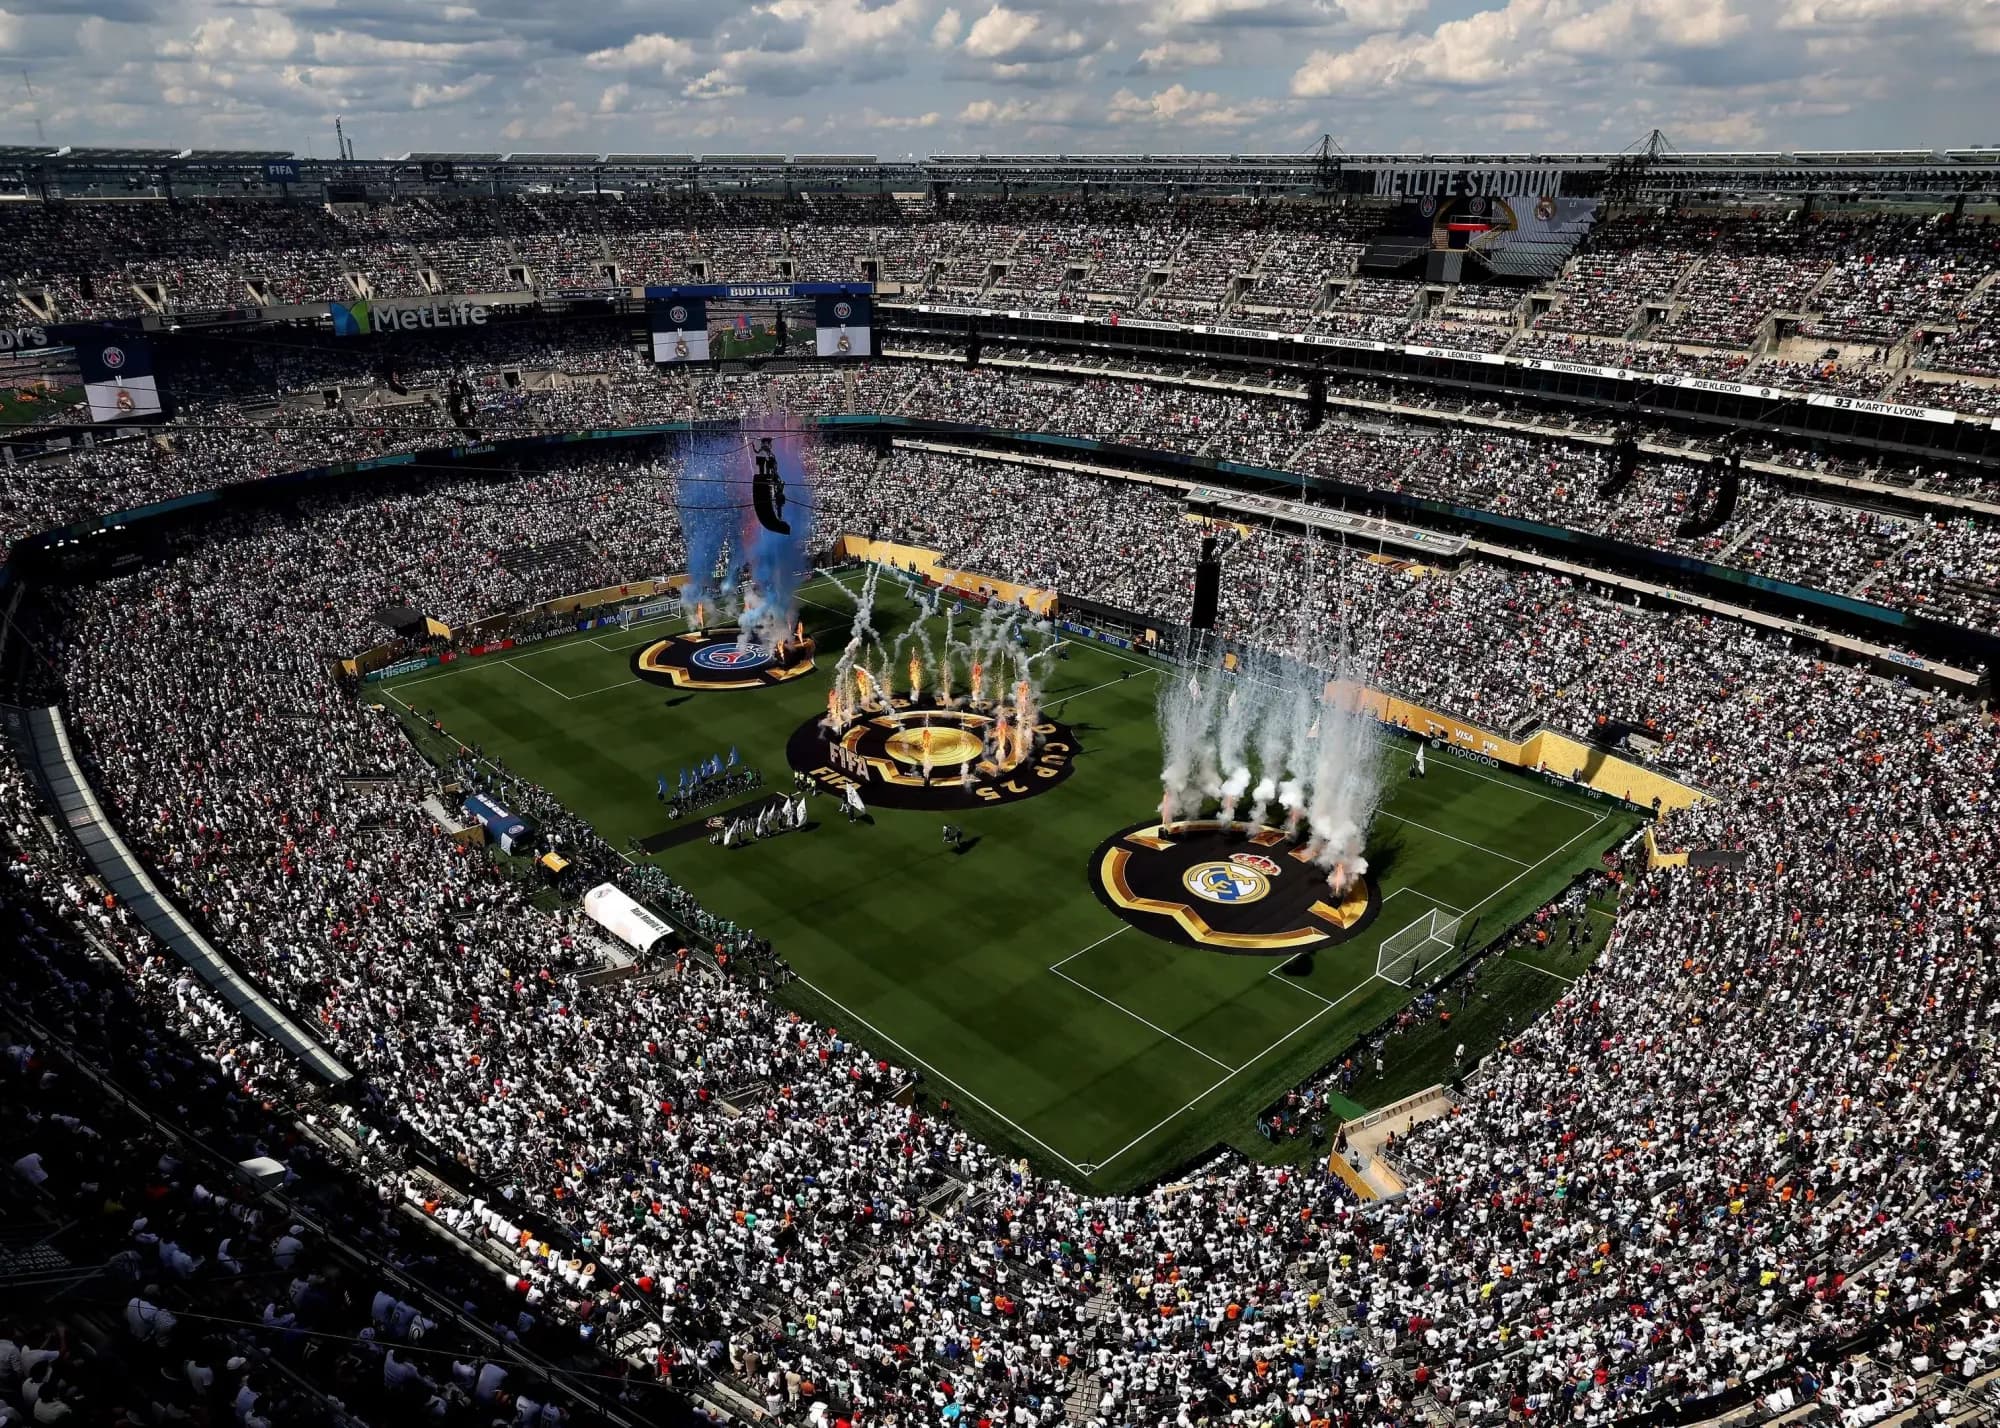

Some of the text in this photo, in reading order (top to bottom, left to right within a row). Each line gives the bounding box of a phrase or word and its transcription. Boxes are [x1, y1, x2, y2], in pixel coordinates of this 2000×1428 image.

[269, 165, 294, 176] FIFA
[1373, 170, 1563, 199] METLIFE STADIUM
[730, 286, 791, 296] BUD LIGHT
[372, 300, 488, 333] MetLife
[1153, 321, 1180, 330] FERGUSON
[1205, 326, 1269, 338] 99 MARK GASTINEAU
[1303, 335, 1376, 348] 60 LARRY GRANTHAM
[1447, 350, 1466, 359] LEON
[1466, 351, 1483, 361] HESS
[1528, 359, 1604, 376] 75 WINSTON HILL
[1692, 379, 1708, 390] JOE
[1708, 381, 1742, 394] KLECKO
[1833, 398, 1927, 418] 93 MARTY LYONS
[1291, 505, 1353, 525] METLIFE STADIUM
[515, 624, 578, 645] QATAR AIRWAYS
[1068, 623, 1084, 635] VISA
[1791, 626, 1818, 639] verizon
[1105, 635, 1121, 647] VISA
[1887, 652, 1925, 669] HCLTech
[380, 660, 428, 680] Hisense
[1455, 728, 1474, 744] VISA
[829, 741, 870, 782] FIFA
[1447, 745, 1500, 769] motorola
[809, 766, 862, 791] FIFA
[975, 743, 1069, 802] CUP 25
[1551, 777, 1565, 789] PIF
[1587, 789, 1602, 800] PIF
[1625, 802, 1640, 813] PIF
